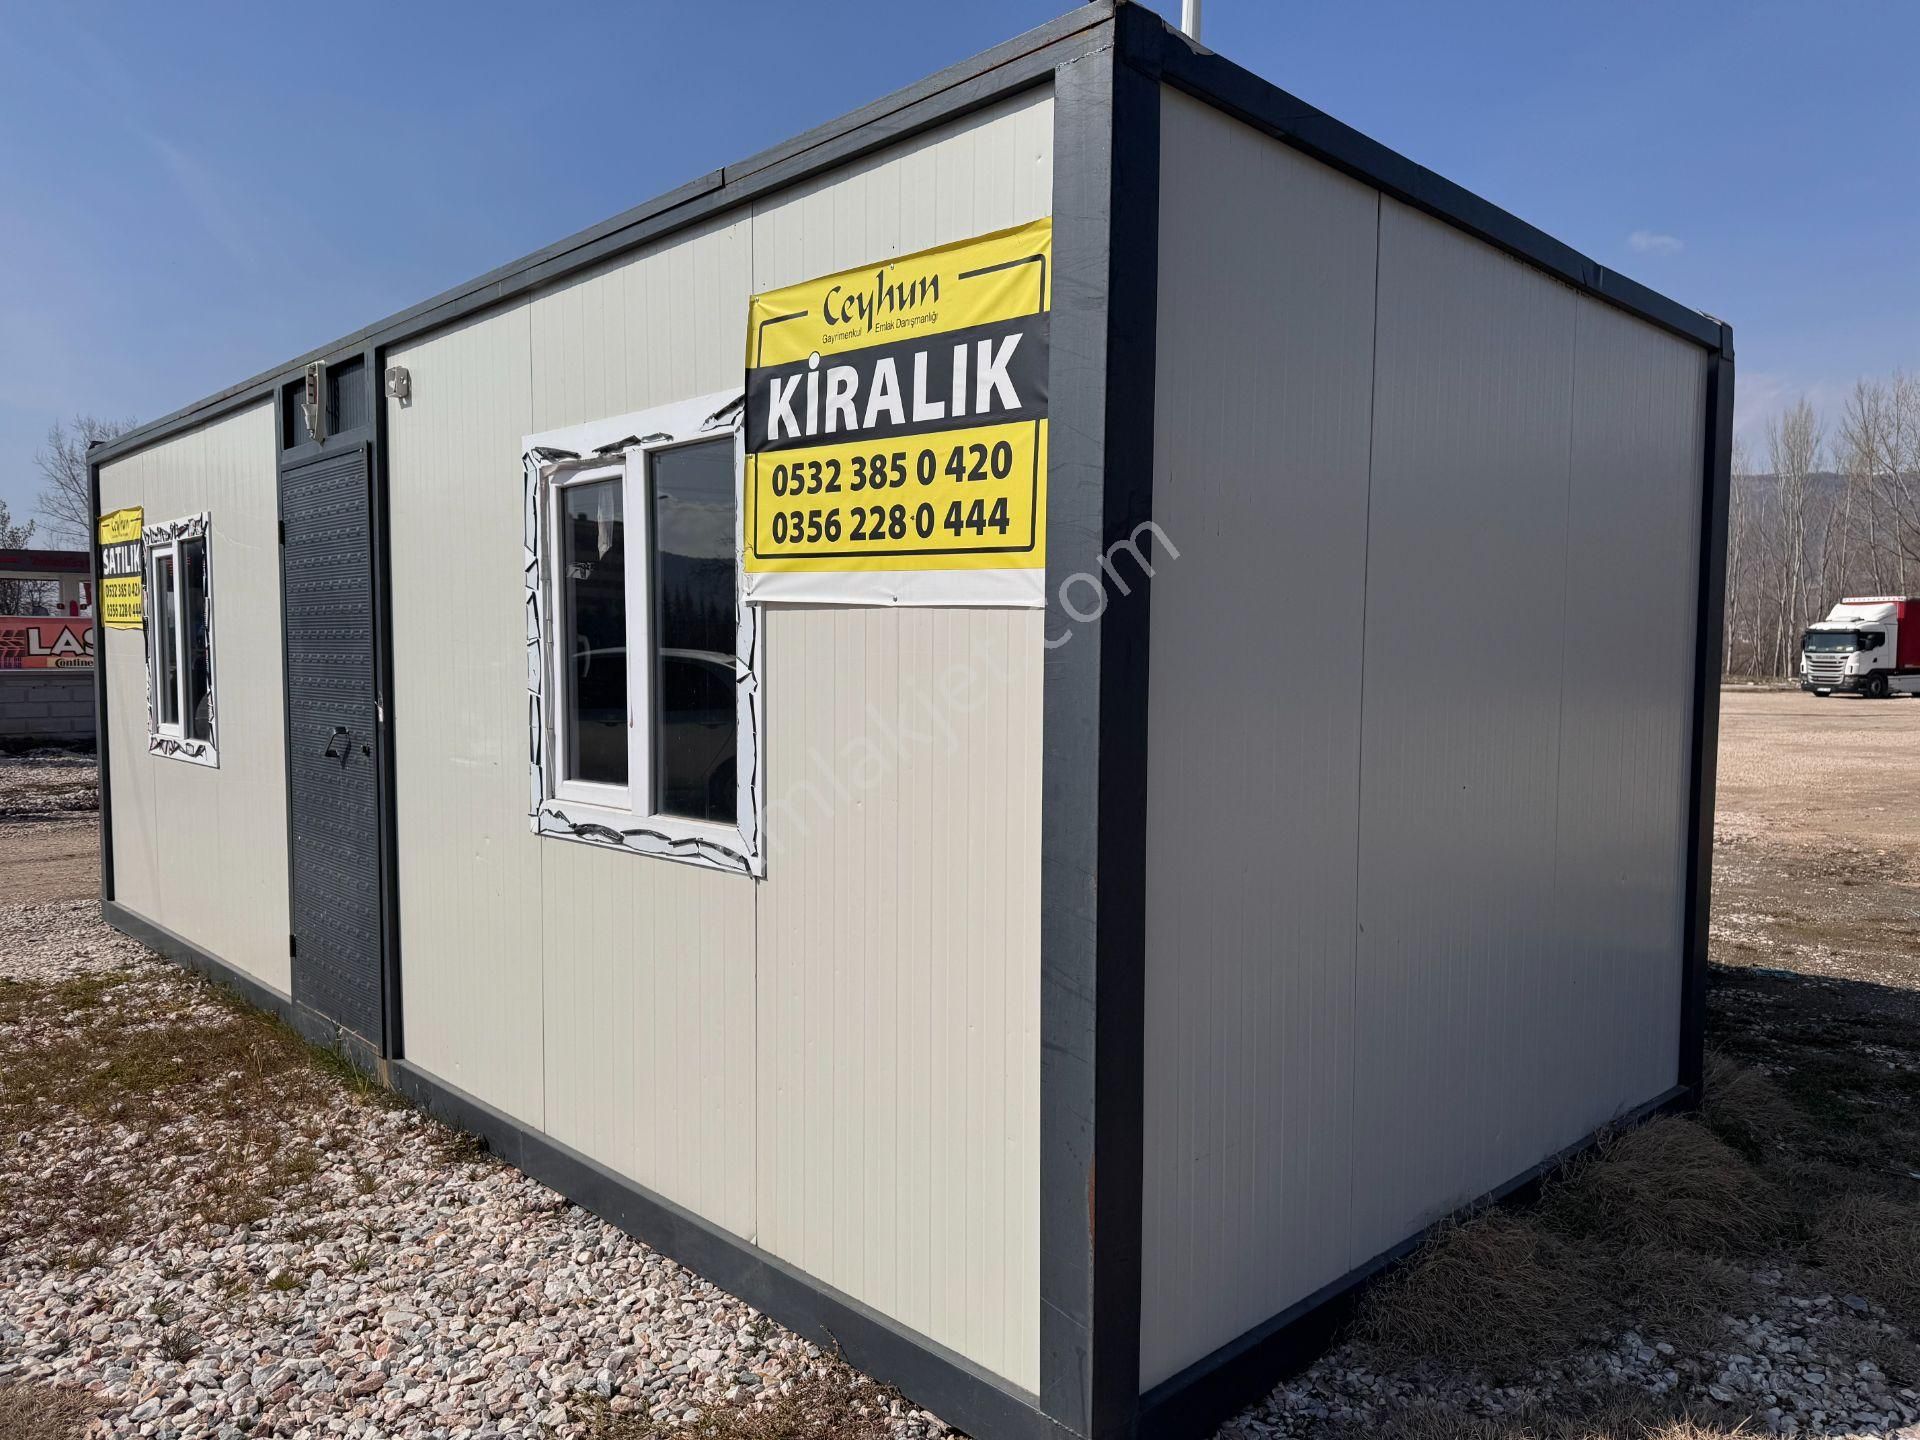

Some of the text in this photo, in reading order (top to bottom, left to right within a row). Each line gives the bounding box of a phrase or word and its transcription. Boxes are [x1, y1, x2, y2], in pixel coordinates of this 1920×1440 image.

[823, 269, 940, 334] Ceyhun
[822, 311, 939, 345] Gayrimenkul Emlak Danışmanlığı
[767, 351, 1024, 441] KİRALIK
[771, 440, 1013, 497] 0532 385 0 420
[771, 497, 1010, 545] 0356 228 0 444
[103, 543, 141, 575] SATILIK
